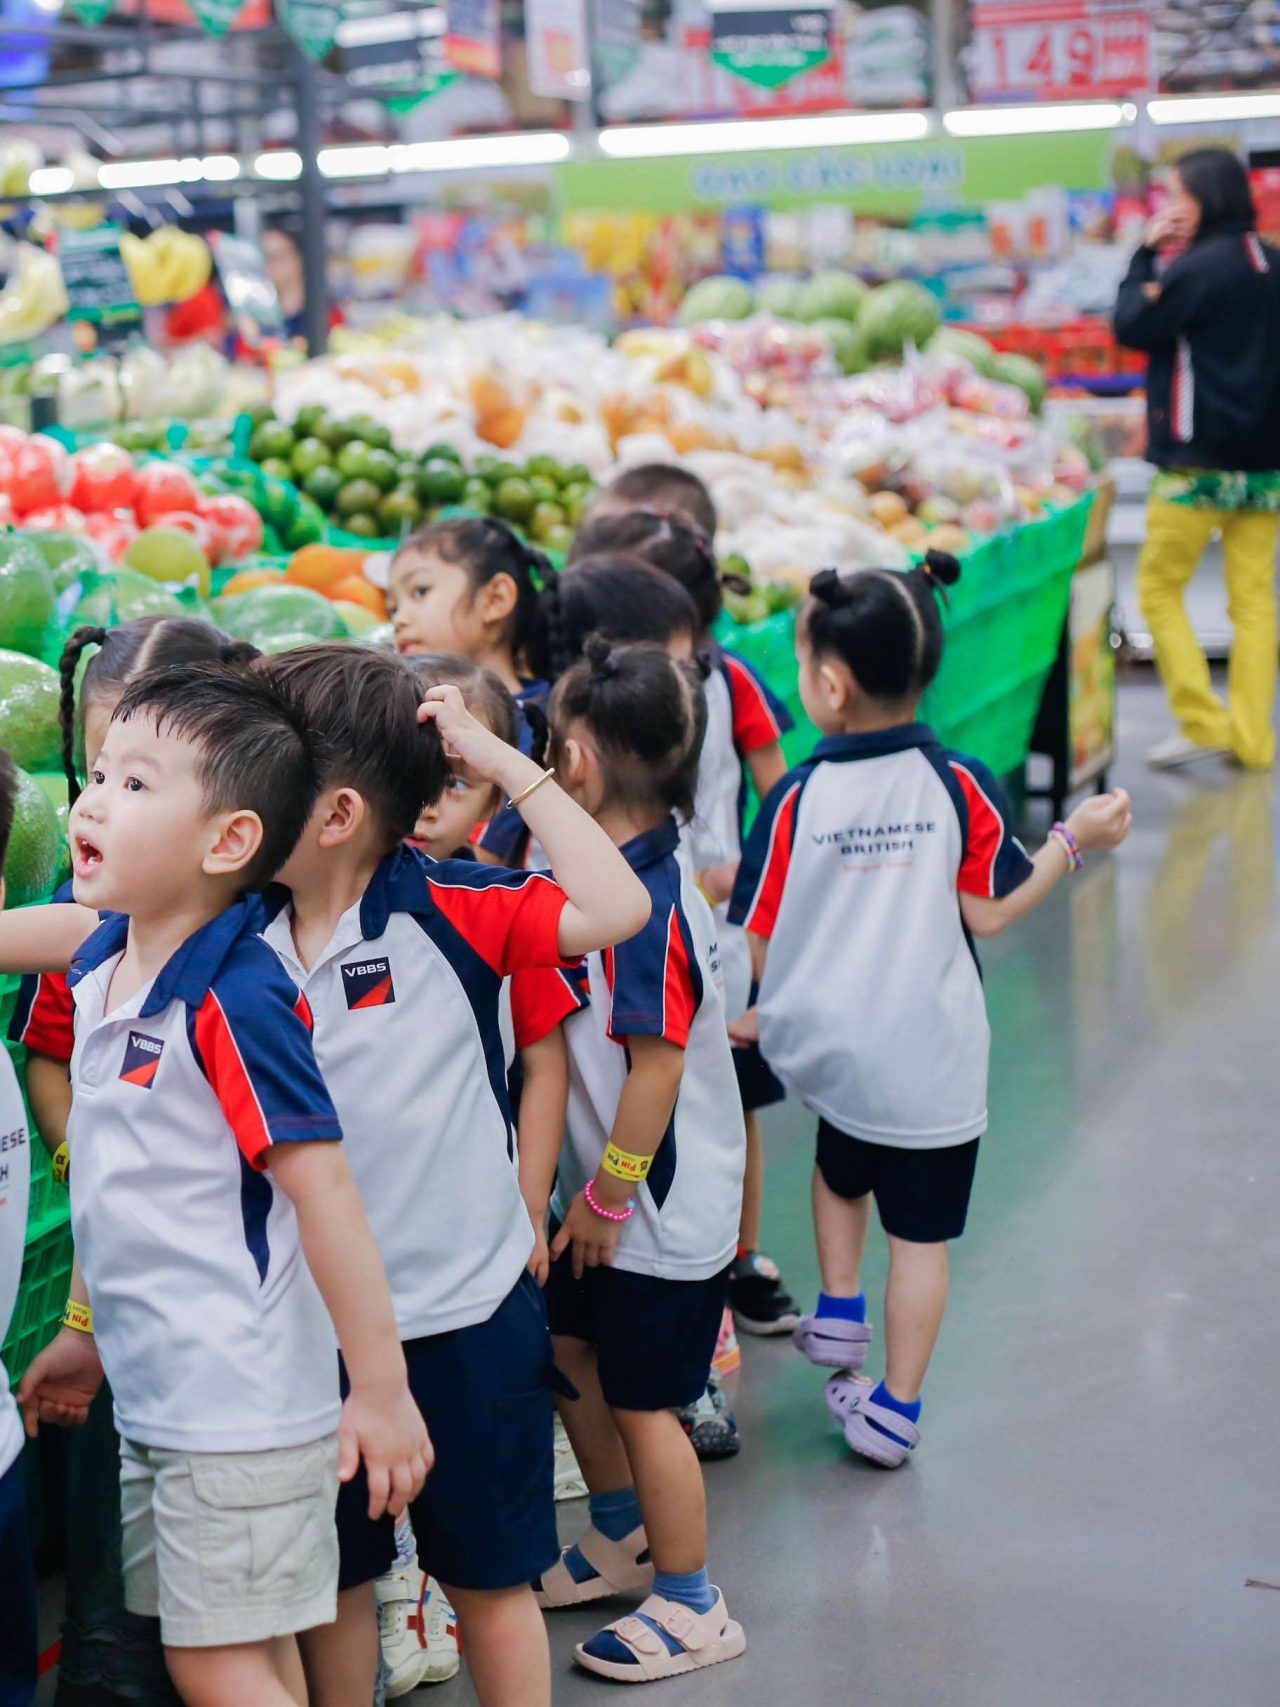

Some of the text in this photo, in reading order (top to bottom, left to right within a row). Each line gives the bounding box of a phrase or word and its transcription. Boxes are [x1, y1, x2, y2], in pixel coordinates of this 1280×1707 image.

[812, 821, 936, 845] VIETNAMESE
[344, 962, 387, 978] VBBS
[130, 1035, 163, 1055] VBBS
